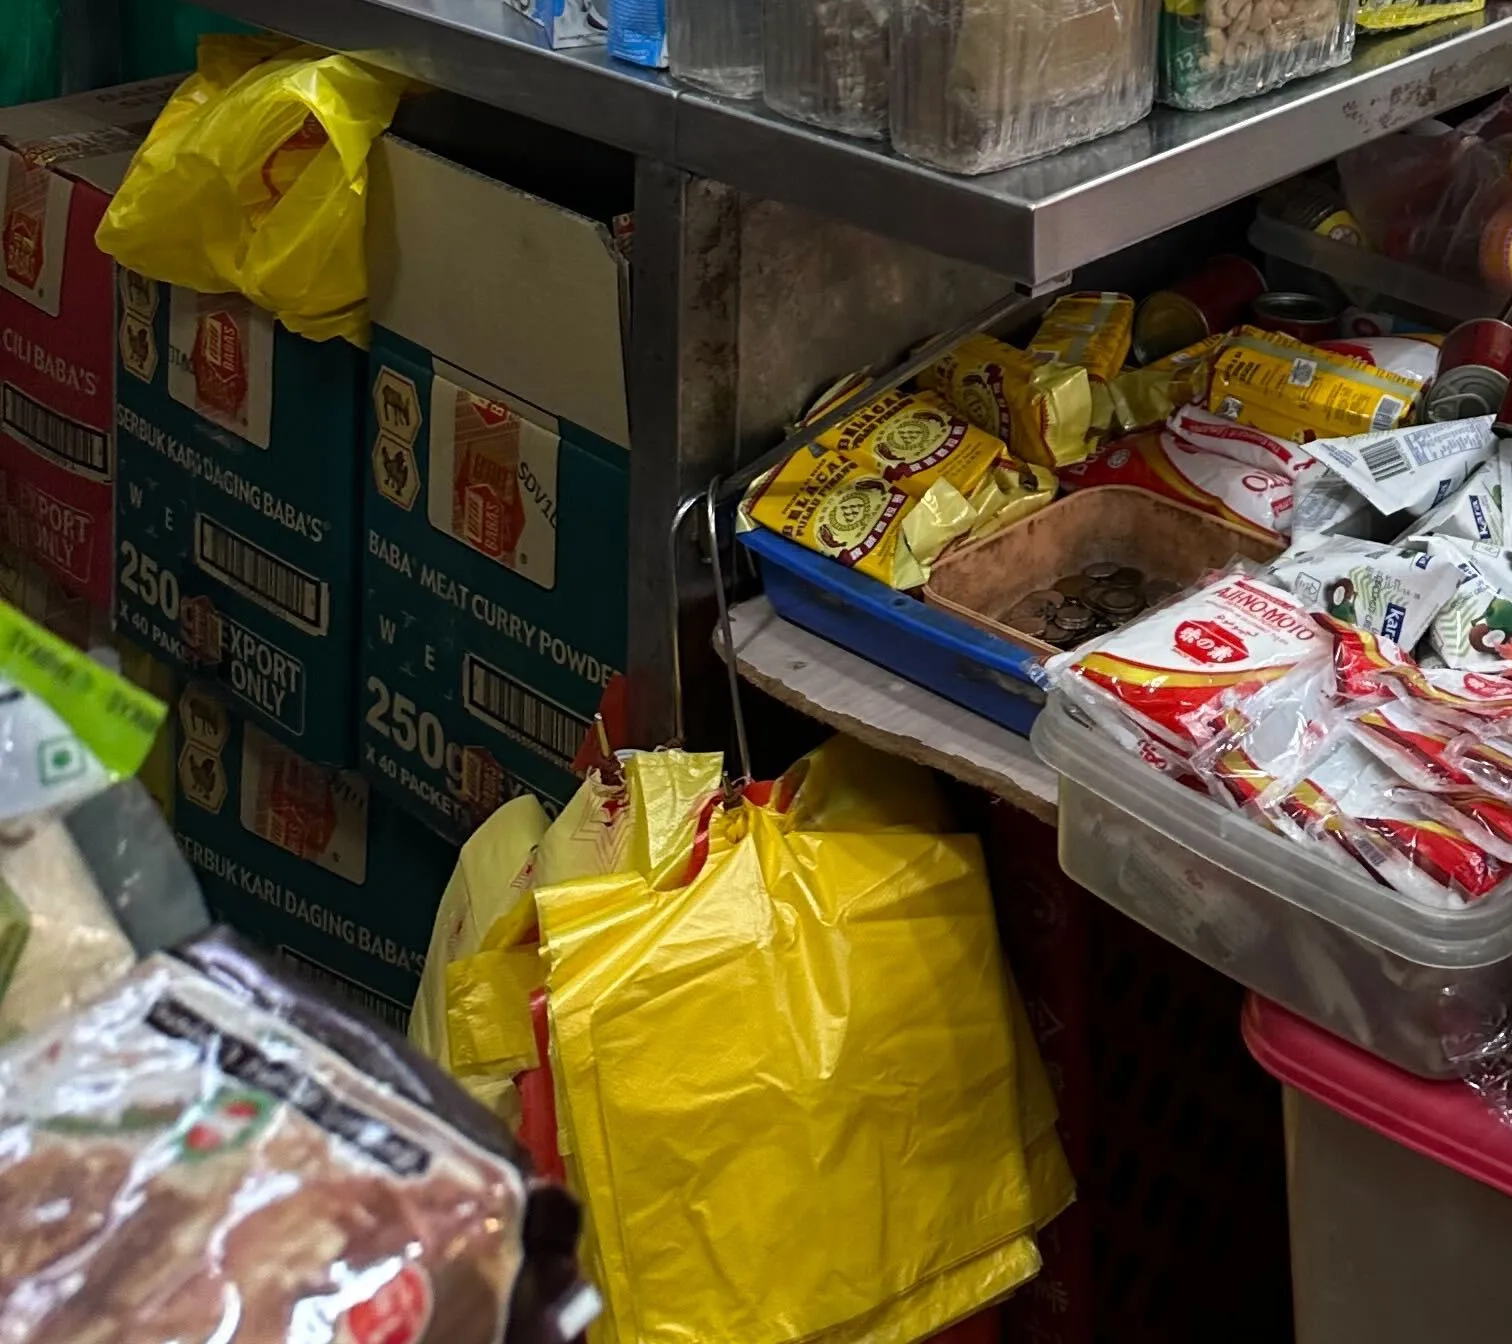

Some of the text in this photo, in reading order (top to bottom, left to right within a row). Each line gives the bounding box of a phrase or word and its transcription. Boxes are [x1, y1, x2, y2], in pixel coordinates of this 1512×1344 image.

[2, 326, 99, 397] CILI BABA'S
[117, 402, 167, 457] SERBUK
[203, 456, 262, 516] DAGING
[262, 489, 325, 545] BABA'S
[128, 481, 144, 506] W
[164, 506, 174, 531] E
[368, 528, 413, 580] BABA
[420, 561, 469, 608] MEAT
[471, 593, 537, 650] CURRY
[131, 611, 148, 636] 40
[379, 614, 397, 646] W
[218, 611, 302, 695] EXPORT
[424, 643, 436, 672] E
[230, 661, 288, 720] ONLY
[377, 748, 398, 780] 40
[240, 867, 355, 946] KARI DAGING
